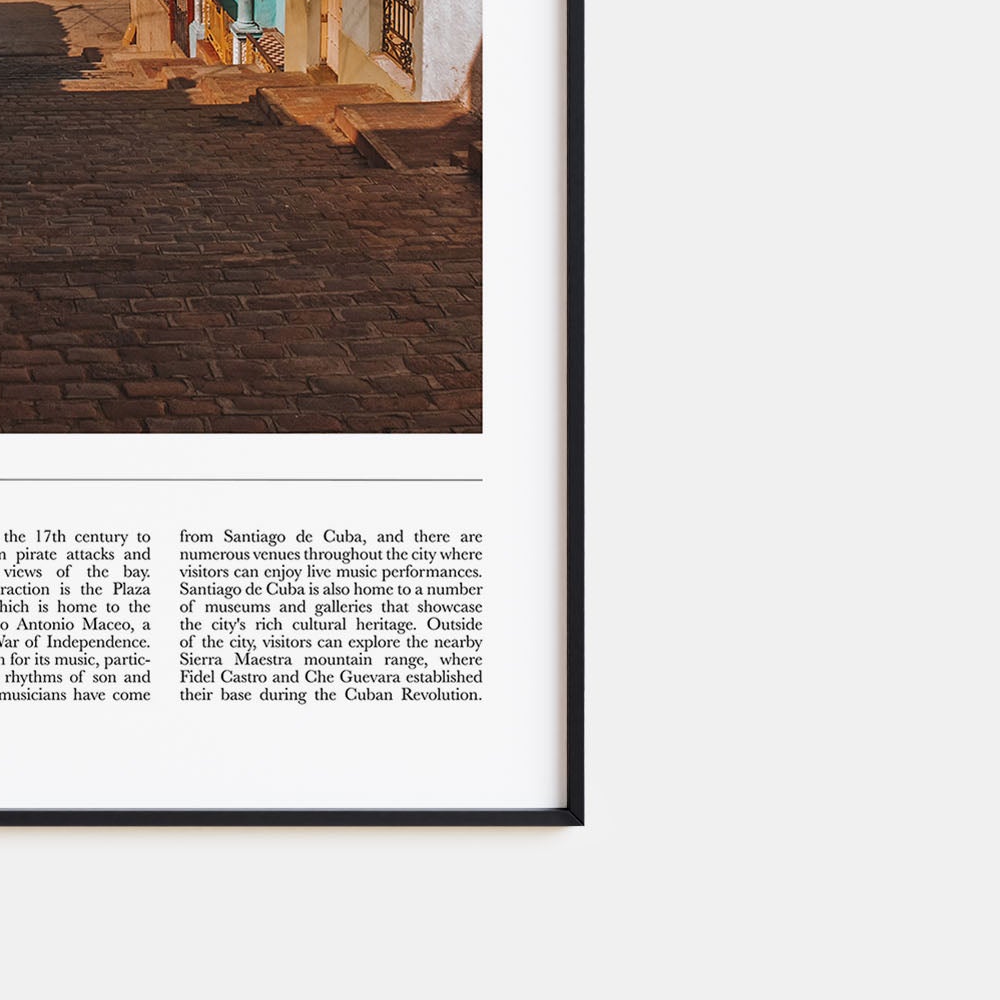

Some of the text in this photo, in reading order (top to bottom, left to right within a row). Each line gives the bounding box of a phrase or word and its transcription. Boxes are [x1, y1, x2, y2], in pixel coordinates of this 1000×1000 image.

[4, 530, 25, 542] the
[37, 530, 65, 542] 17th
[75, 533, 128, 546] century
[137, 533, 150, 542] to
[180, 530, 482, 546] from Santiago de Cuba, and there are
[4, 565, 42, 578] views
[56, 565, 72, 577] of
[87, 565, 108, 577] the
[124, 565, 150, 581] bay.
[180, 565, 481, 581] visitors can enjoy live music performances.
[39, 600, 48, 613] is
[58, 600, 96, 613] home
[107, 603, 119, 613] to
[129, 600, 150, 613] the
[180, 600, 482, 616] of museums and galleries that showcase
[17, 618, 74, 630] Antonio
[83, 618, 134, 633] Maceo,
[143, 622, 150, 630] a
[180, 618, 482, 634] the city's rich cultural heritage. Outside
[11, 653, 30, 665] for
[35, 653, 50, 665] its
[55, 653, 99, 668] music,
[104, 653, 150, 669] partic-
[180, 653, 482, 669] Sierra Maestra mountain range, where
[5, 670, 62, 687] rhythms
[70, 670, 85, 683] of
[93, 674, 116, 683] son
[124, 670, 150, 683] and
[181, 670, 482, 683] Fidel Castro and Che Guevara established
[74, 688, 105, 700] have
[113, 692, 150, 700] come
[180, 688, 481, 704] their base during the Cuban Revolution.
